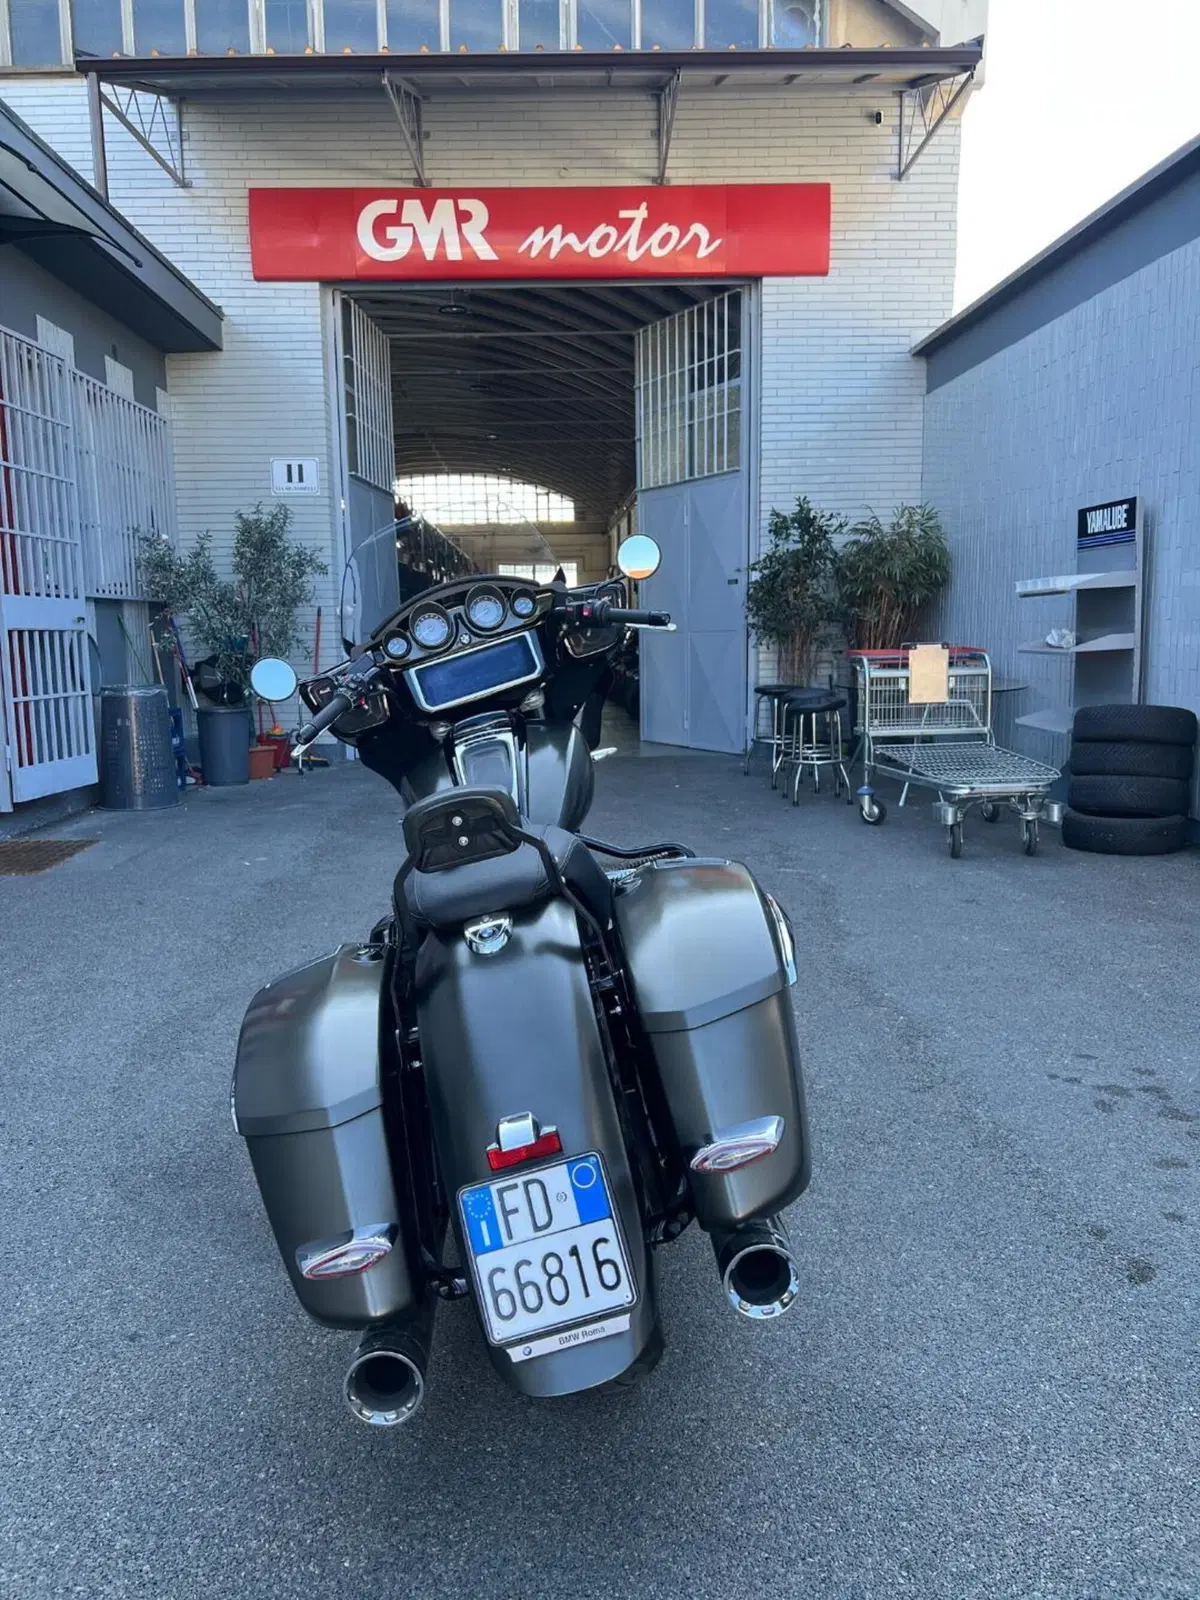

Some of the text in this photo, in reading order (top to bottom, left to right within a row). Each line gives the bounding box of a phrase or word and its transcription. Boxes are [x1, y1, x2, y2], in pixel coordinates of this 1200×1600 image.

[356, 198, 723, 262] GMR motor
[1086, 503, 1130, 534] YAMALUBE
[496, 1178, 553, 1241] FD
[487, 1237, 622, 1321] 66816
[558, 1325, 606, 1346] BMW Roma
